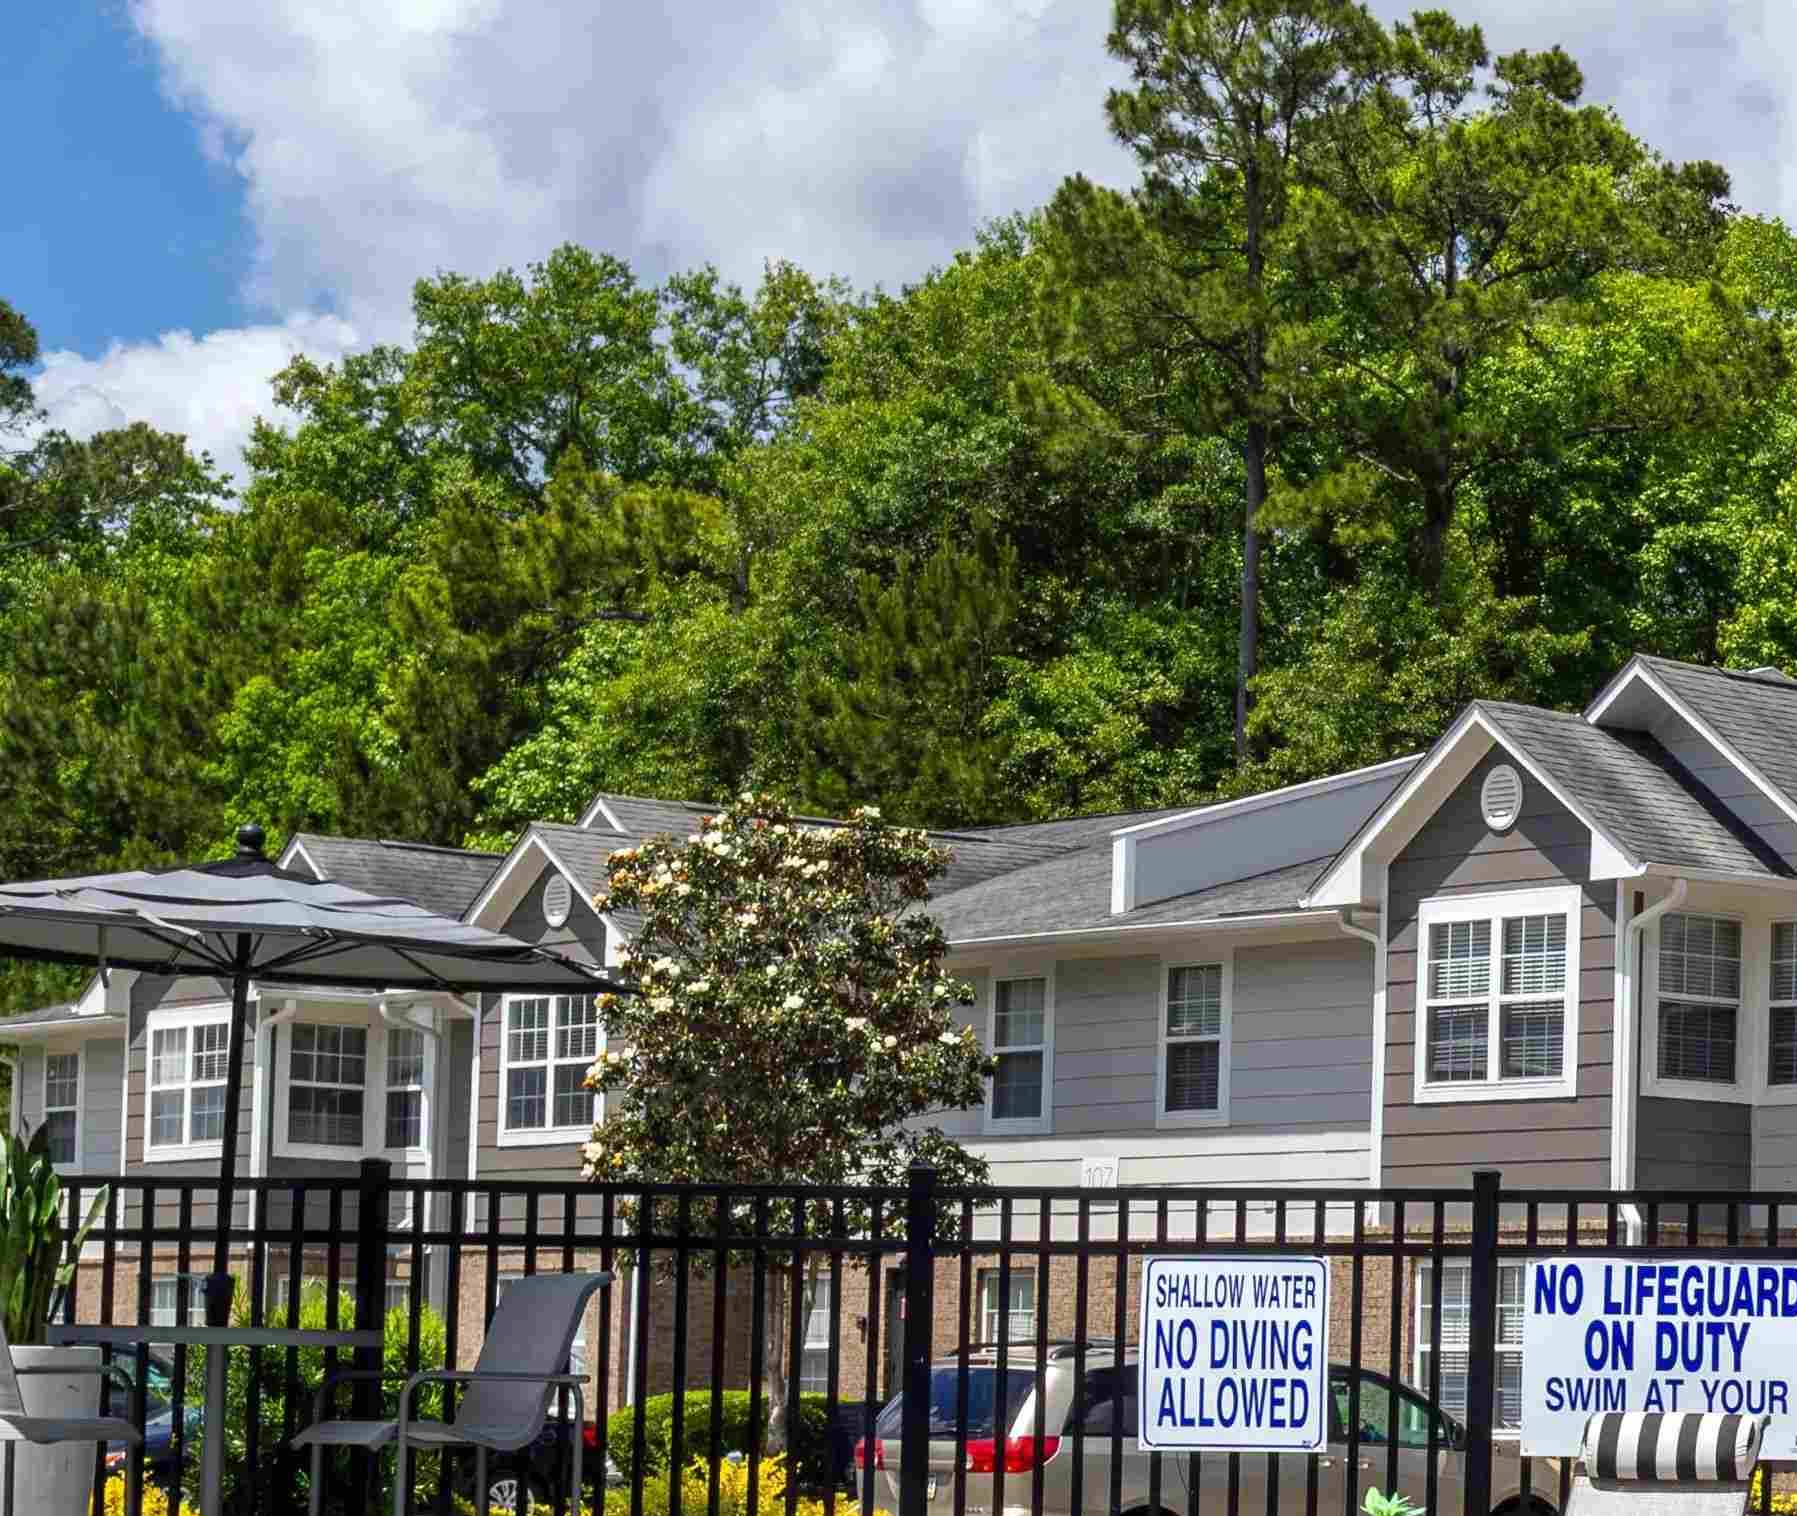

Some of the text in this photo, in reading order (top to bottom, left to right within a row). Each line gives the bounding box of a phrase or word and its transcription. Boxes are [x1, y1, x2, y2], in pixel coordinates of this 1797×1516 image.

[1156, 1273, 1316, 1309] SHALLOW WATER
[1534, 1264, 1584, 1315] NO
[1154, 1318, 1313, 1371] NO DIVING
[1584, 1319, 1751, 1373] ON DUTY
[1156, 1376, 1310, 1429] ALLOWED
[1545, 1376, 1788, 1415] SWIM AT YOUR
